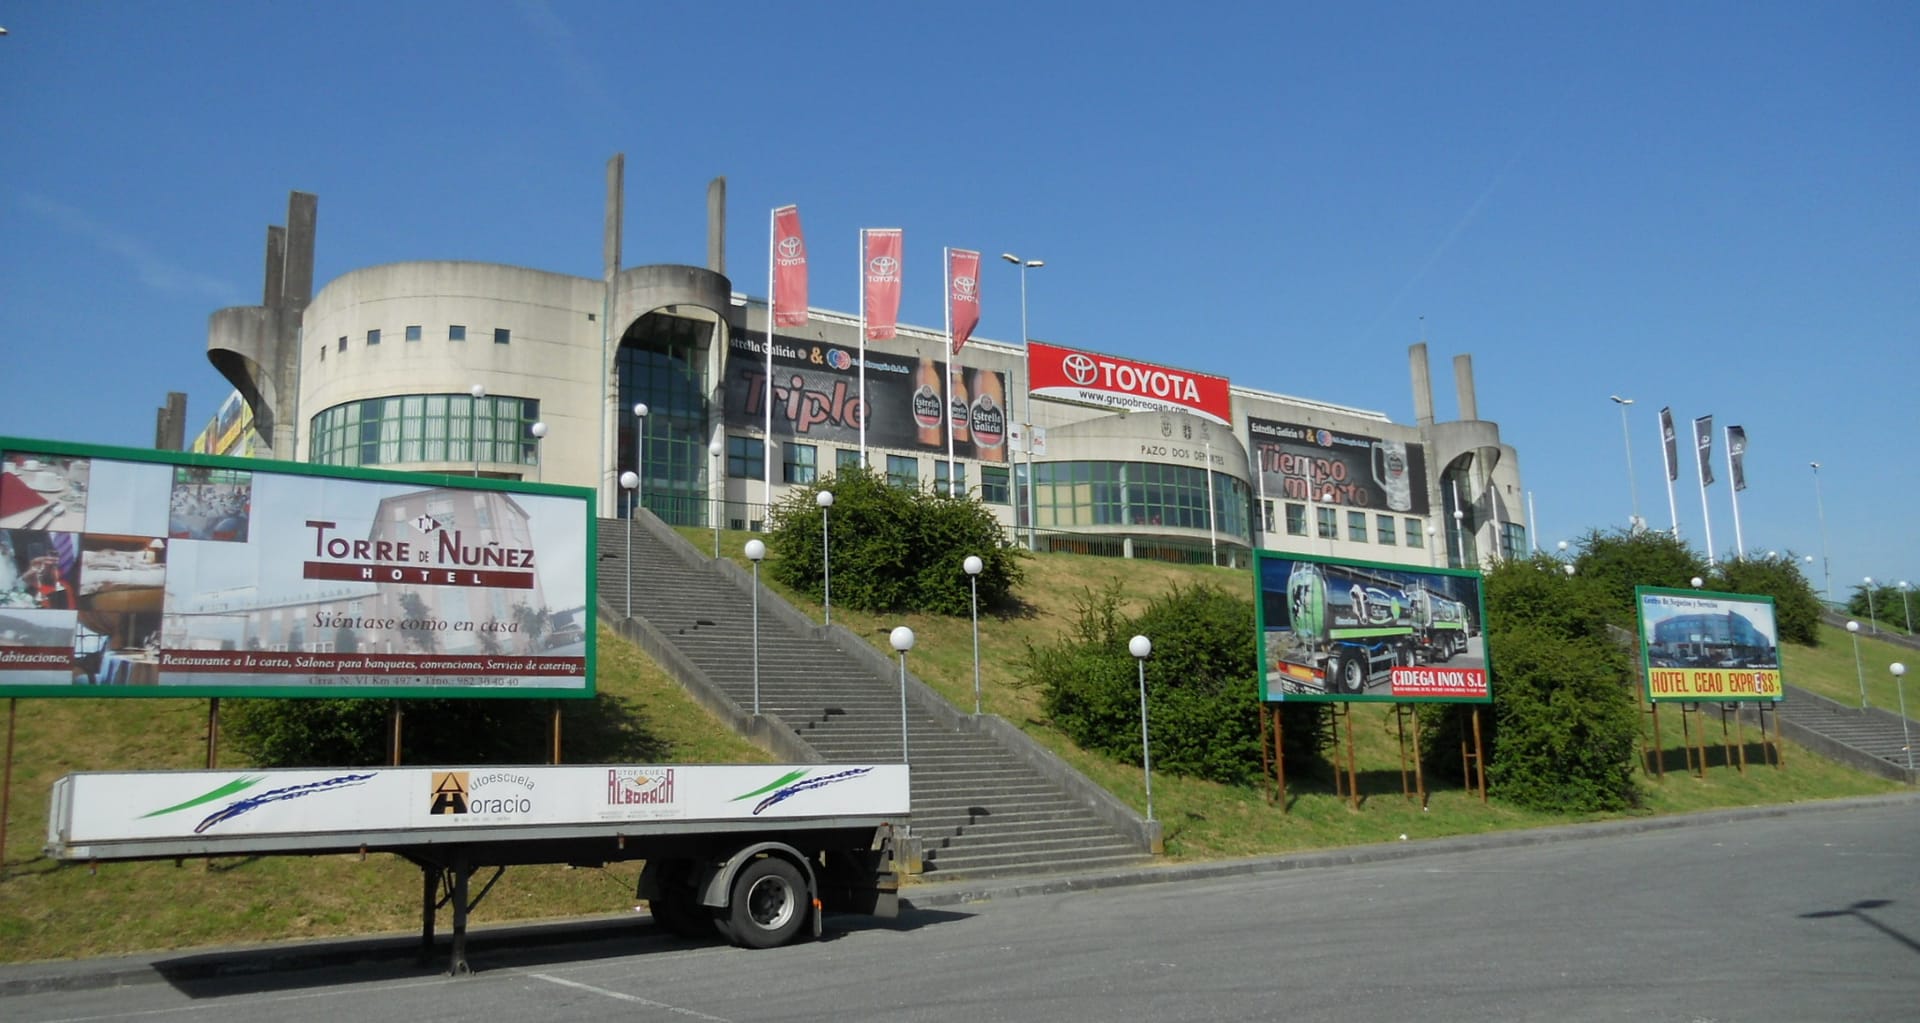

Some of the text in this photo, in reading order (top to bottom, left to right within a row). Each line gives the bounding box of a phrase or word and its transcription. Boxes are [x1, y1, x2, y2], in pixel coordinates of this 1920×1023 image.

[777, 257, 807, 267] TOYOTA
[868, 274, 900, 284] TOYOTA
[730, 336, 761, 353] strella
[810, 346, 824, 366] &
[1099, 361, 1201, 403] TOYOTA
[743, 369, 872, 434] Triple
[1078, 389, 1189, 415] www.grupobreogan.com
[973, 409, 1001, 424] Estrella
[974, 420, 1001, 433] Galicia
[1141, 444, 1167, 457] PAZO
[1172, 448, 1190, 459] DOS
[1257, 443, 1348, 485] Tiempo
[1283, 475, 1369, 507] muerto
[305, 520, 410, 562] TORRE
[362, 567, 482, 584] HOTEL
[312, 610, 519, 633] Siéntase como en casa
[162, 653, 231, 667] Restaurante
[233, 658, 242, 667] a
[245, 655, 256, 667] la
[260, 657, 293, 669] carta,
[295, 656, 335, 669] Salones
[337, 659, 362, 672] para
[364, 657, 418, 673] banquetes,
[420, 660, 485, 672] convenciones,
[486, 660, 523, 671] Servicio
[526, 660, 537, 671] de
[1392, 670, 1487, 688] CIDEGA INOX S.L.
[1651, 671, 1690, 693] HOTEL
[1694, 672, 1723, 693] CEAO
